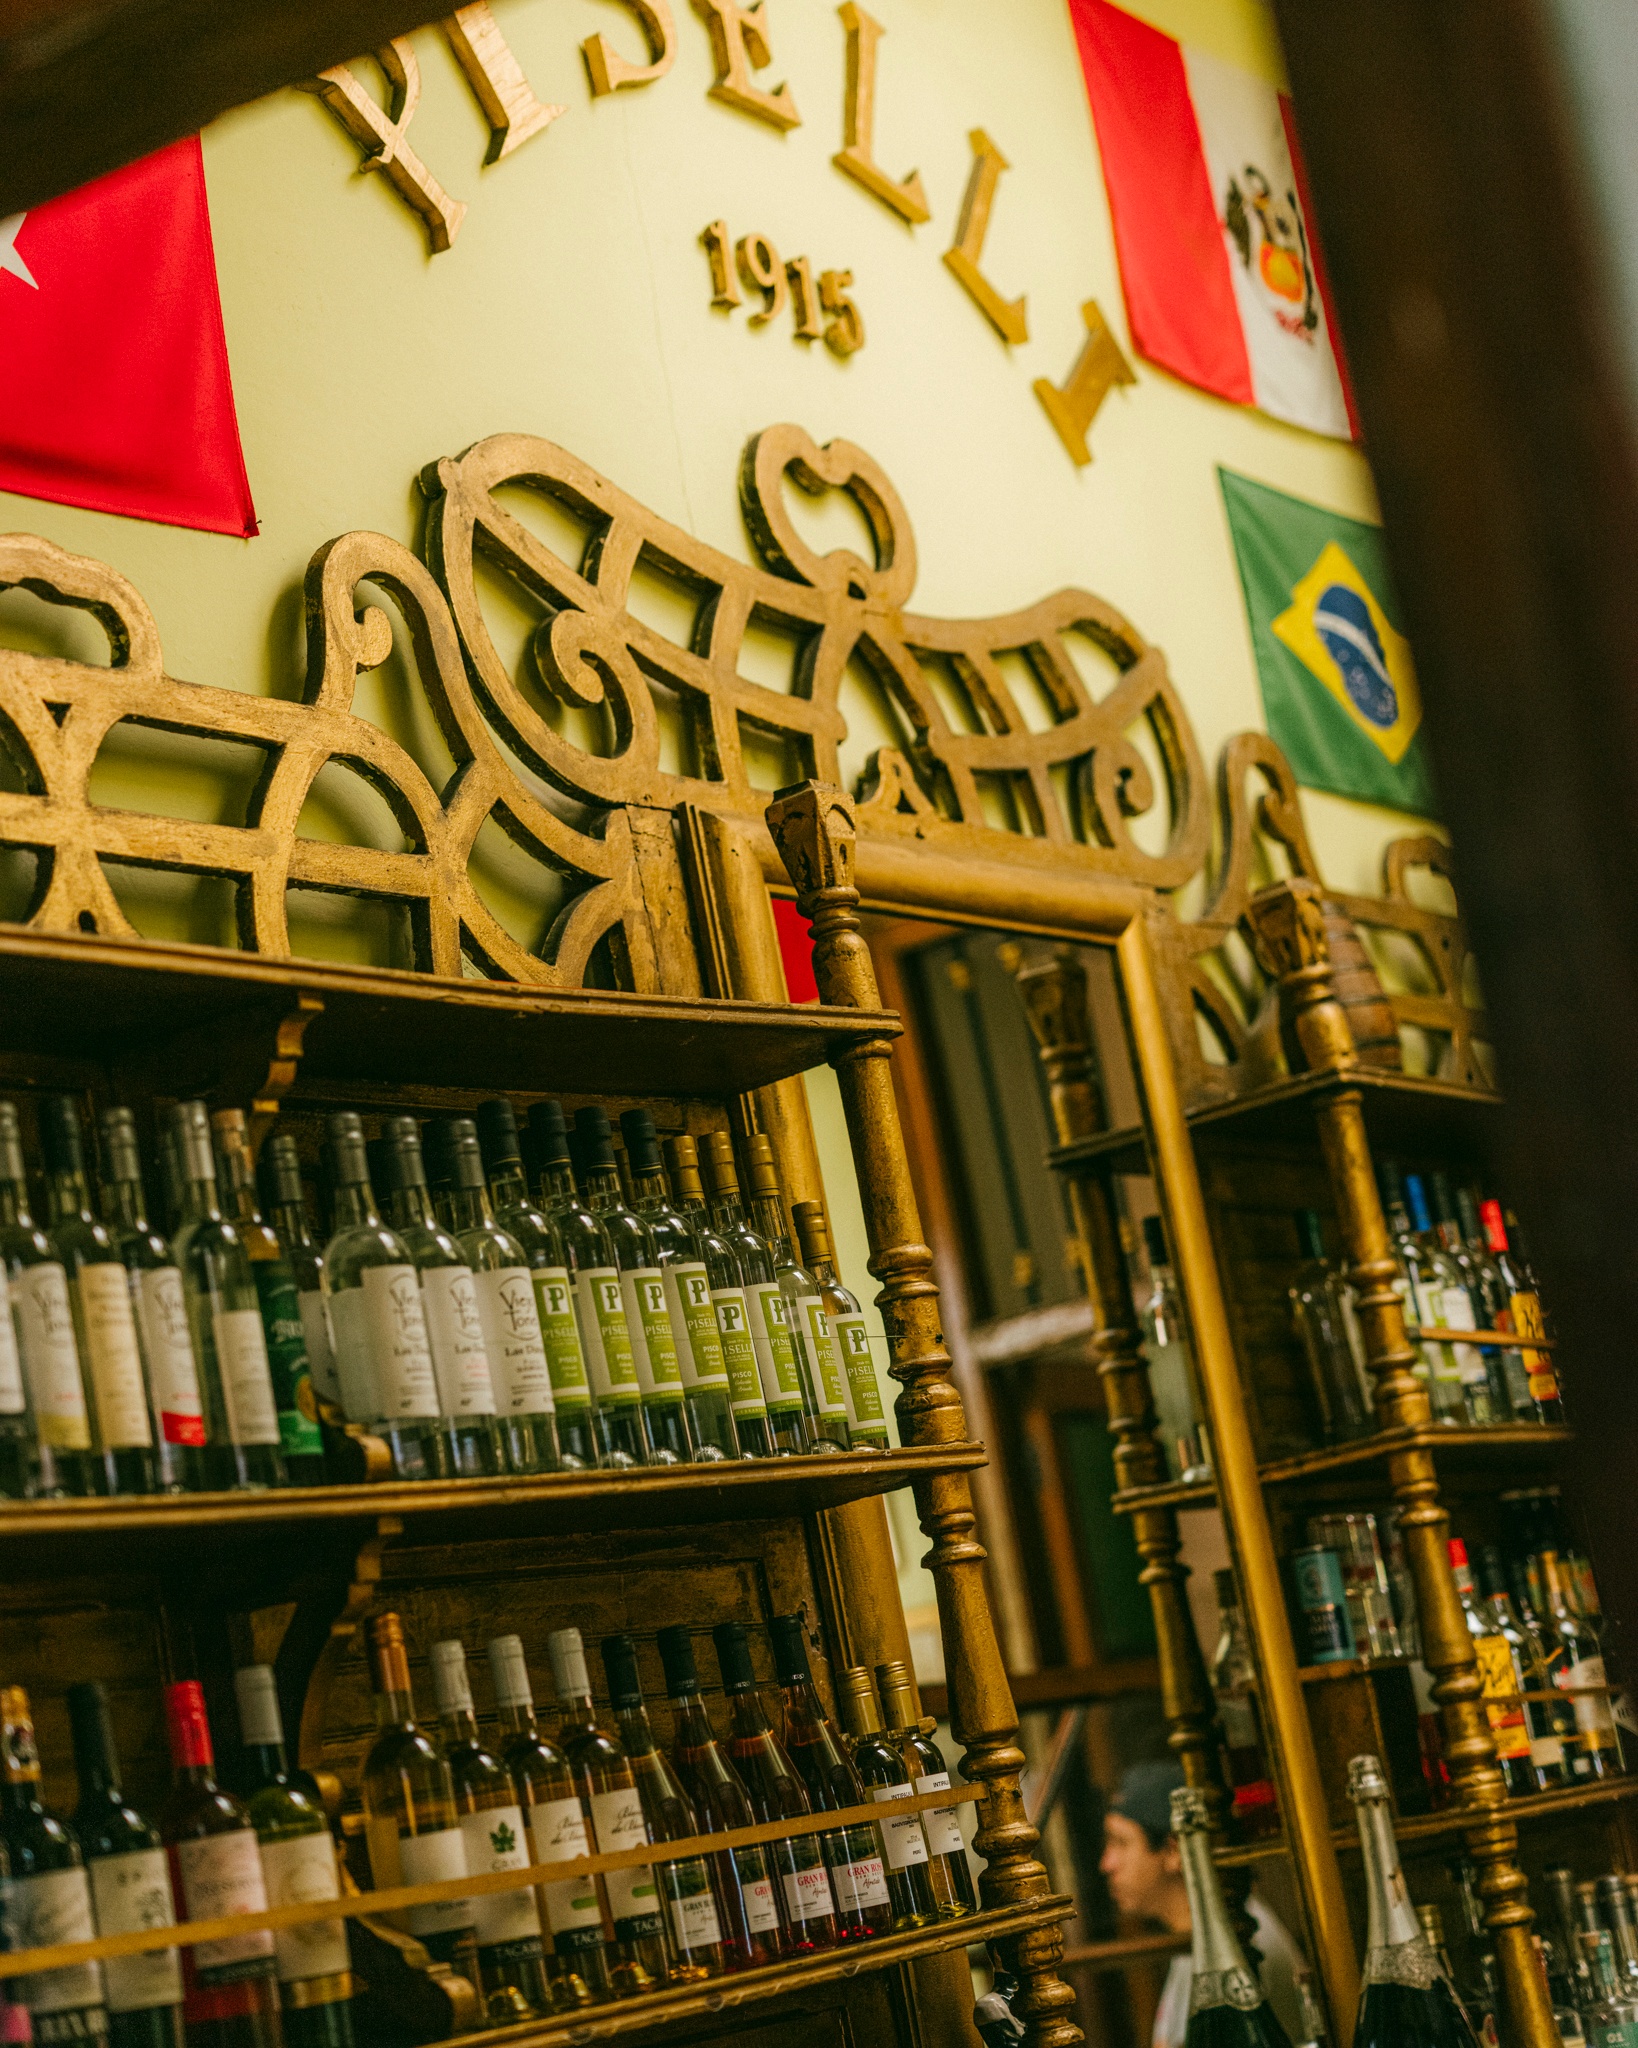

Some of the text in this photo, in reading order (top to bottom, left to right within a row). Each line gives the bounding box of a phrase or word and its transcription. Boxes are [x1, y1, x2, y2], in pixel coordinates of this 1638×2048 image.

[700, 220, 866, 359] 1915
[547, 1287, 564, 1312] P
[604, 1285, 618, 1309] P
[648, 1285, 662, 1309] P
[690, 1280, 705, 1303] P
[721, 1306, 740, 1330] P
[850, 1329, 865, 1352] P
[732, 1371, 752, 1379] PISCO
[862, 1391, 878, 1399] PISCO
[797, 1873, 818, 1887] GRAN
[847, 1864, 869, 1878] GRAN
